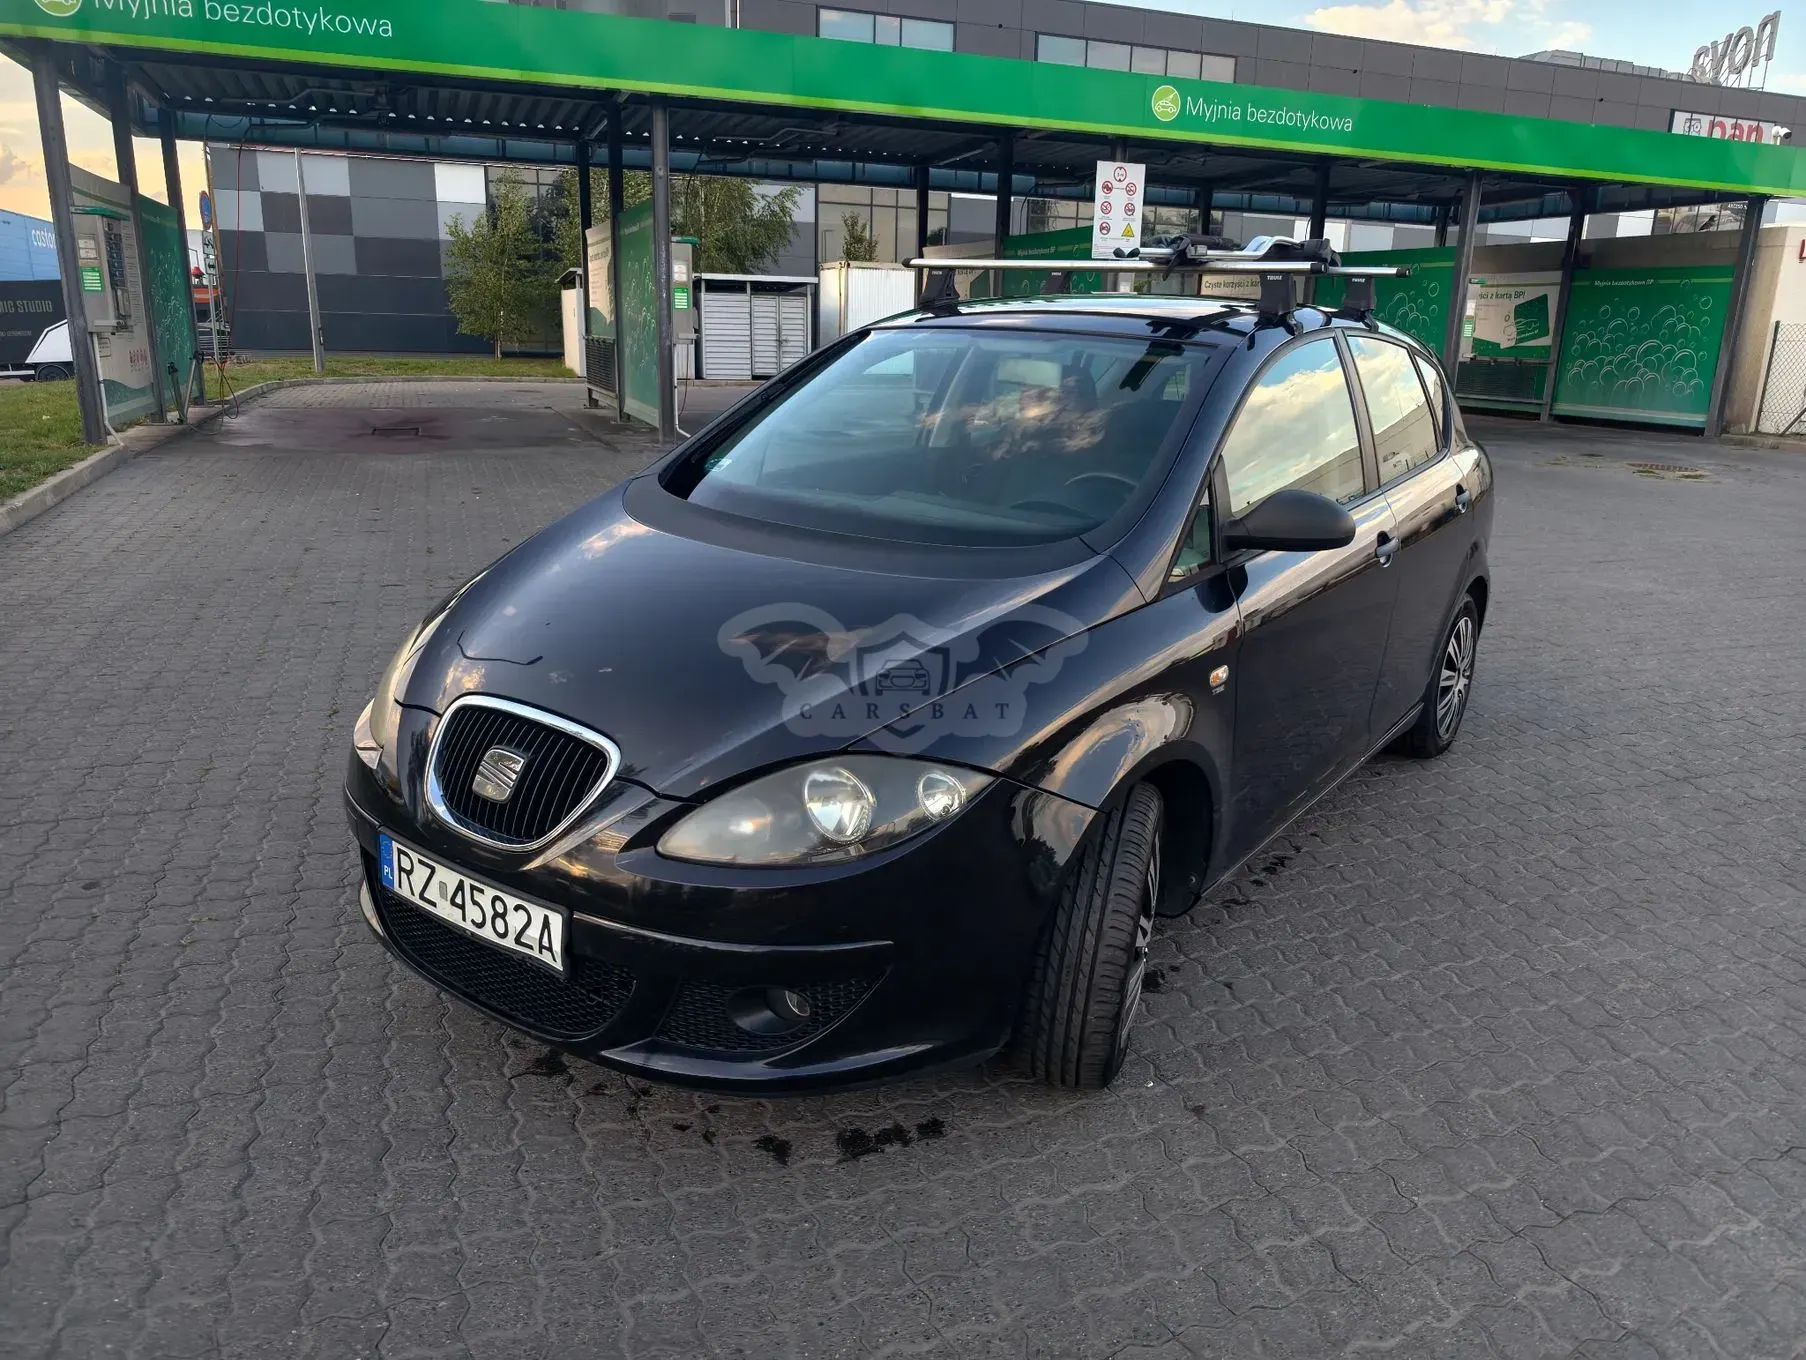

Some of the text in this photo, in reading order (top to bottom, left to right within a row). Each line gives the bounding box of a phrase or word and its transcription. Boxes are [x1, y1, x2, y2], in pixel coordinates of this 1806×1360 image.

[204, 0, 393, 38] bezdotykowa
[1186, 96, 1353, 132] Myjnia bezdotykowa
[16, 300, 53, 313] STUDIO
[383, 865, 393, 880] PL
[396, 846, 558, 963] RZ 4582A
